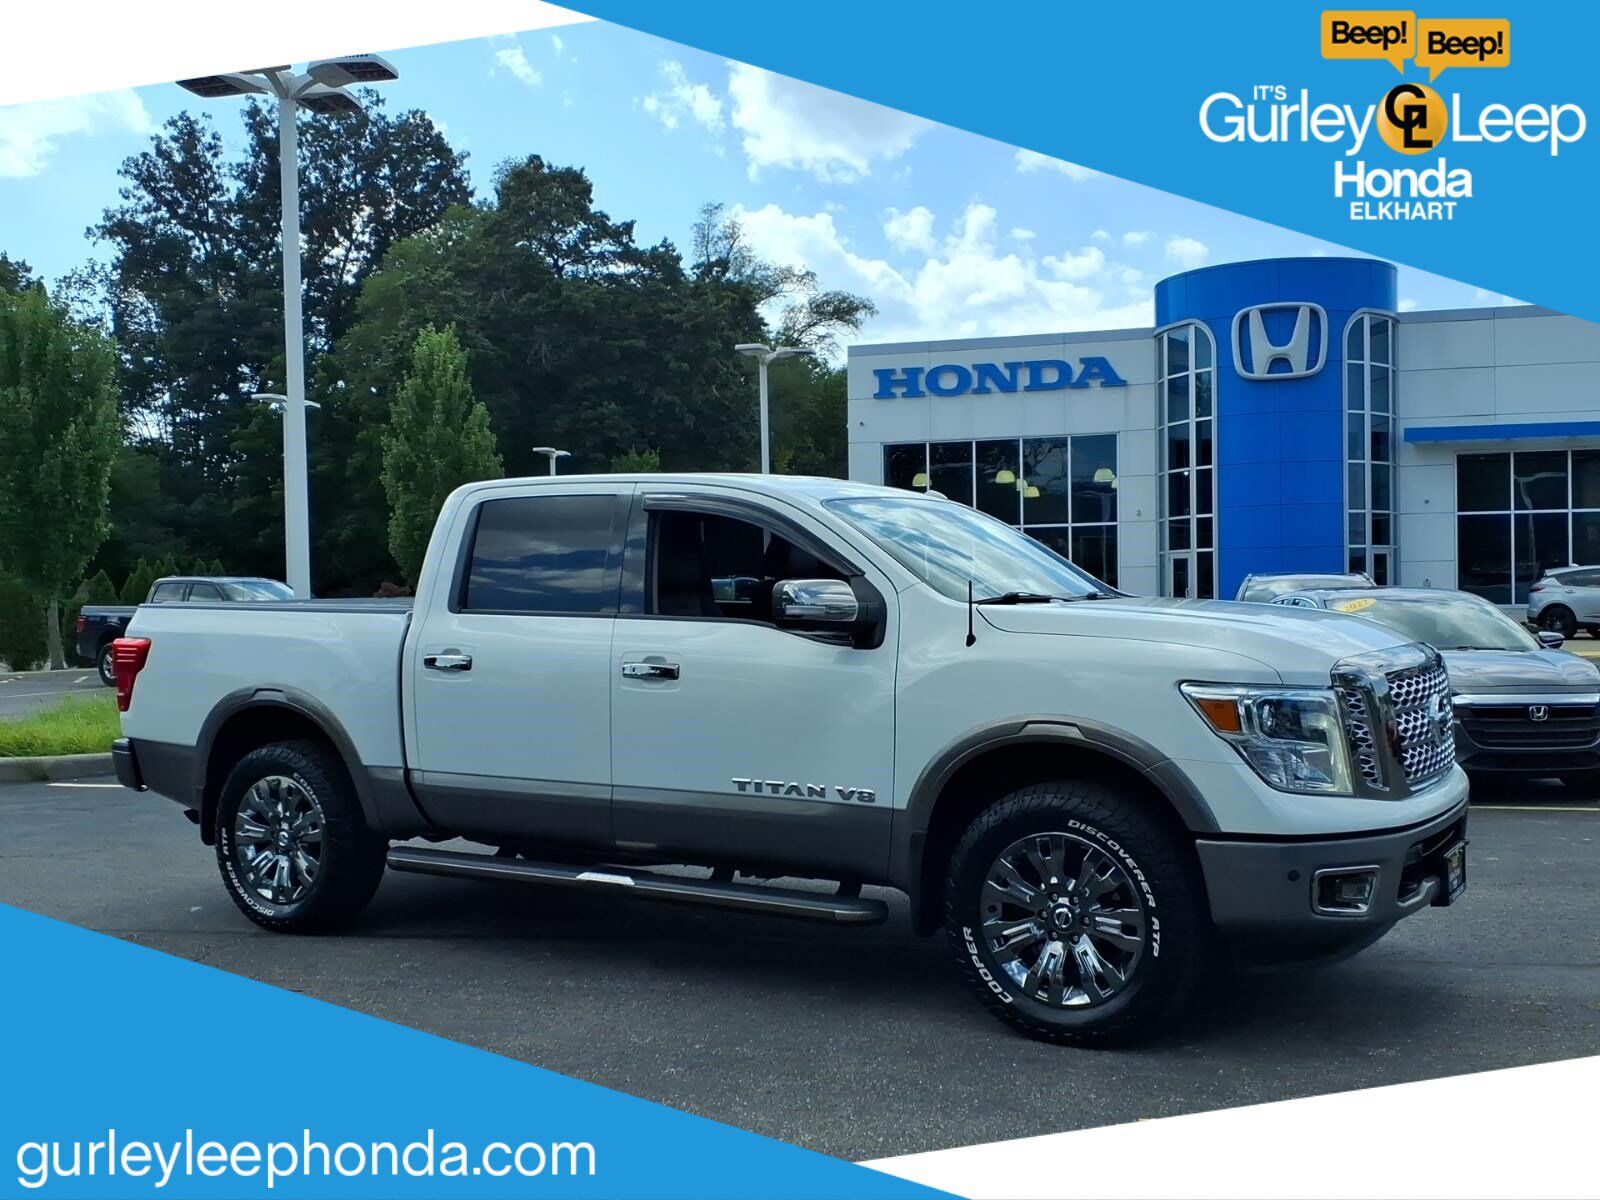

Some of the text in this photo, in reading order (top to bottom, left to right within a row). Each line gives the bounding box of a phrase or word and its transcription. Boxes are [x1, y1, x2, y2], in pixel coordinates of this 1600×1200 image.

[872, 355, 1128, 400] HONDA
[731, 777, 876, 803] TITAN V8
[1067, 819, 1156, 908] DISCOVERER
[962, 926, 1014, 1004] COOPER
